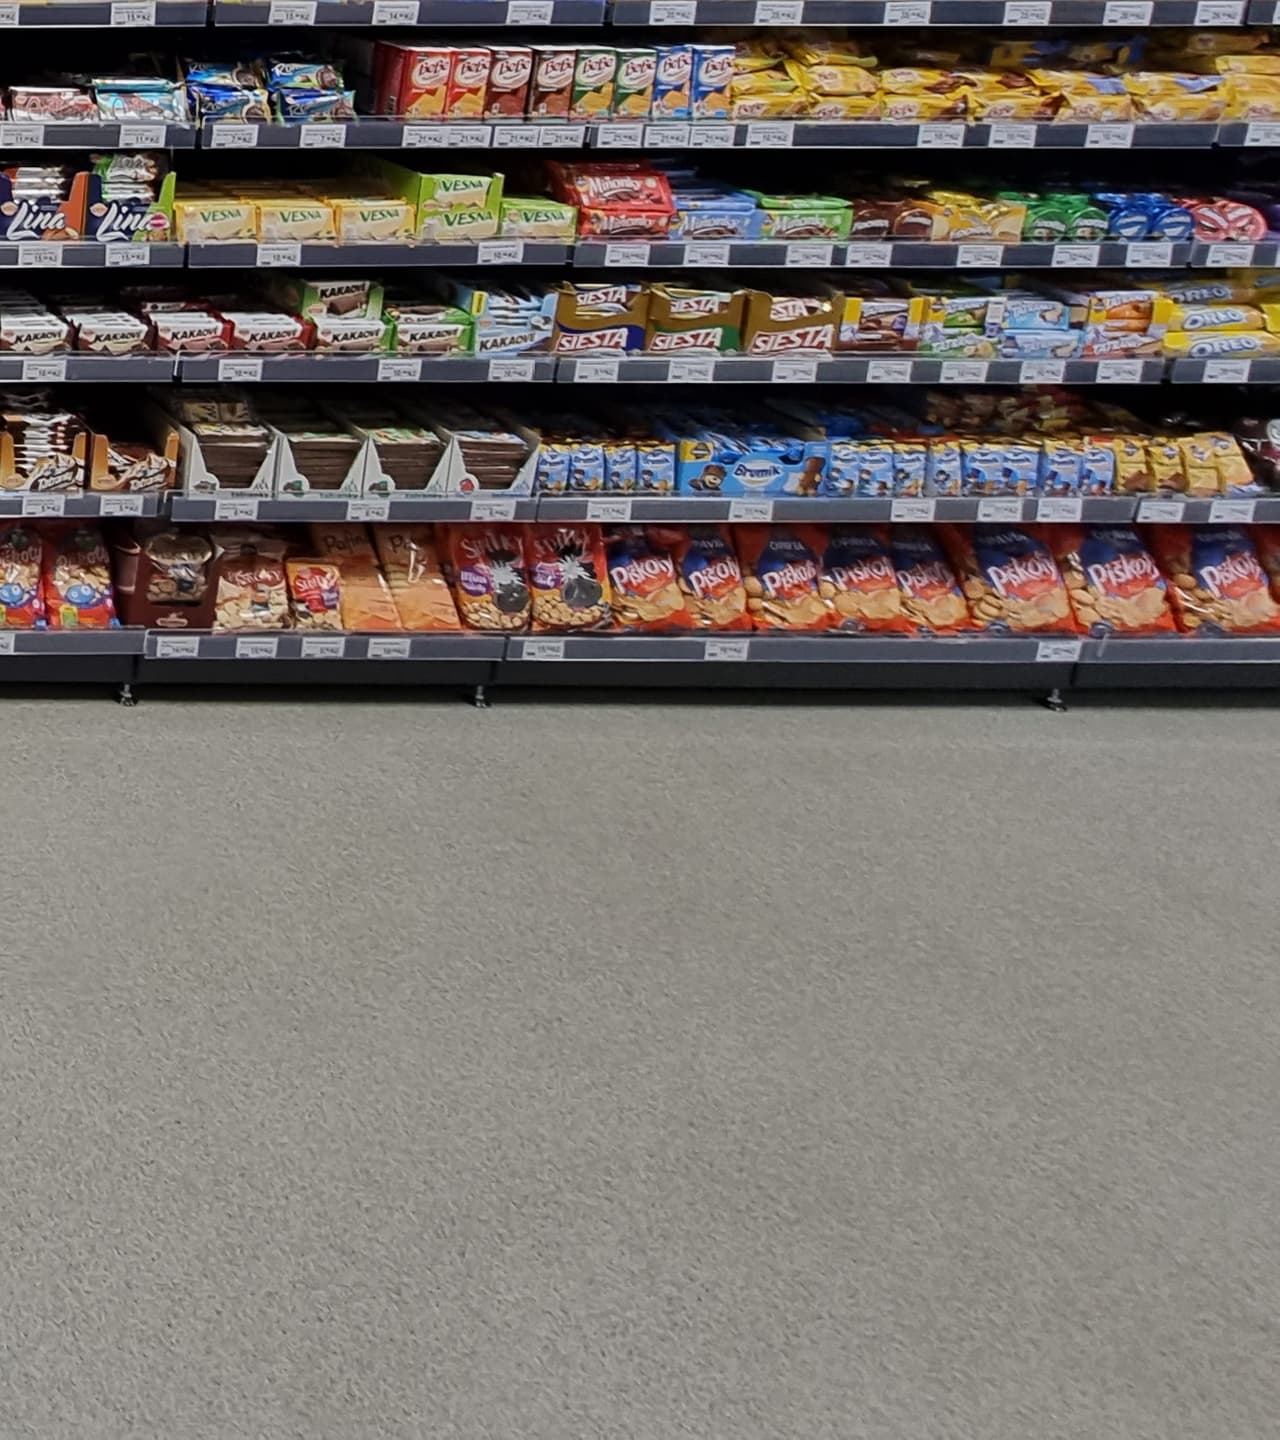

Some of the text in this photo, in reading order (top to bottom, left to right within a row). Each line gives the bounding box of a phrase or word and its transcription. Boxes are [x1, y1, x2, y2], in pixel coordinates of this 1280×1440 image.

[441, 178, 484, 192] VESNA
[6, 201, 66, 241] Lina
[96, 201, 153, 241] Lina
[199, 208, 242, 224] VESNA
[278, 208, 322, 223] VESNA
[360, 208, 400, 222] VESNA
[442, 210, 493, 226] VESNA
[523, 208, 565, 223] VESNA
[576, 288, 627, 306] SIESTA
[1182, 308, 1245, 329] OREO
[557, 329, 627, 351] SIESTA
[651, 329, 721, 351] SIESTA
[752, 330, 832, 352] SIESTA
[1190, 338, 1257, 357] OREO
